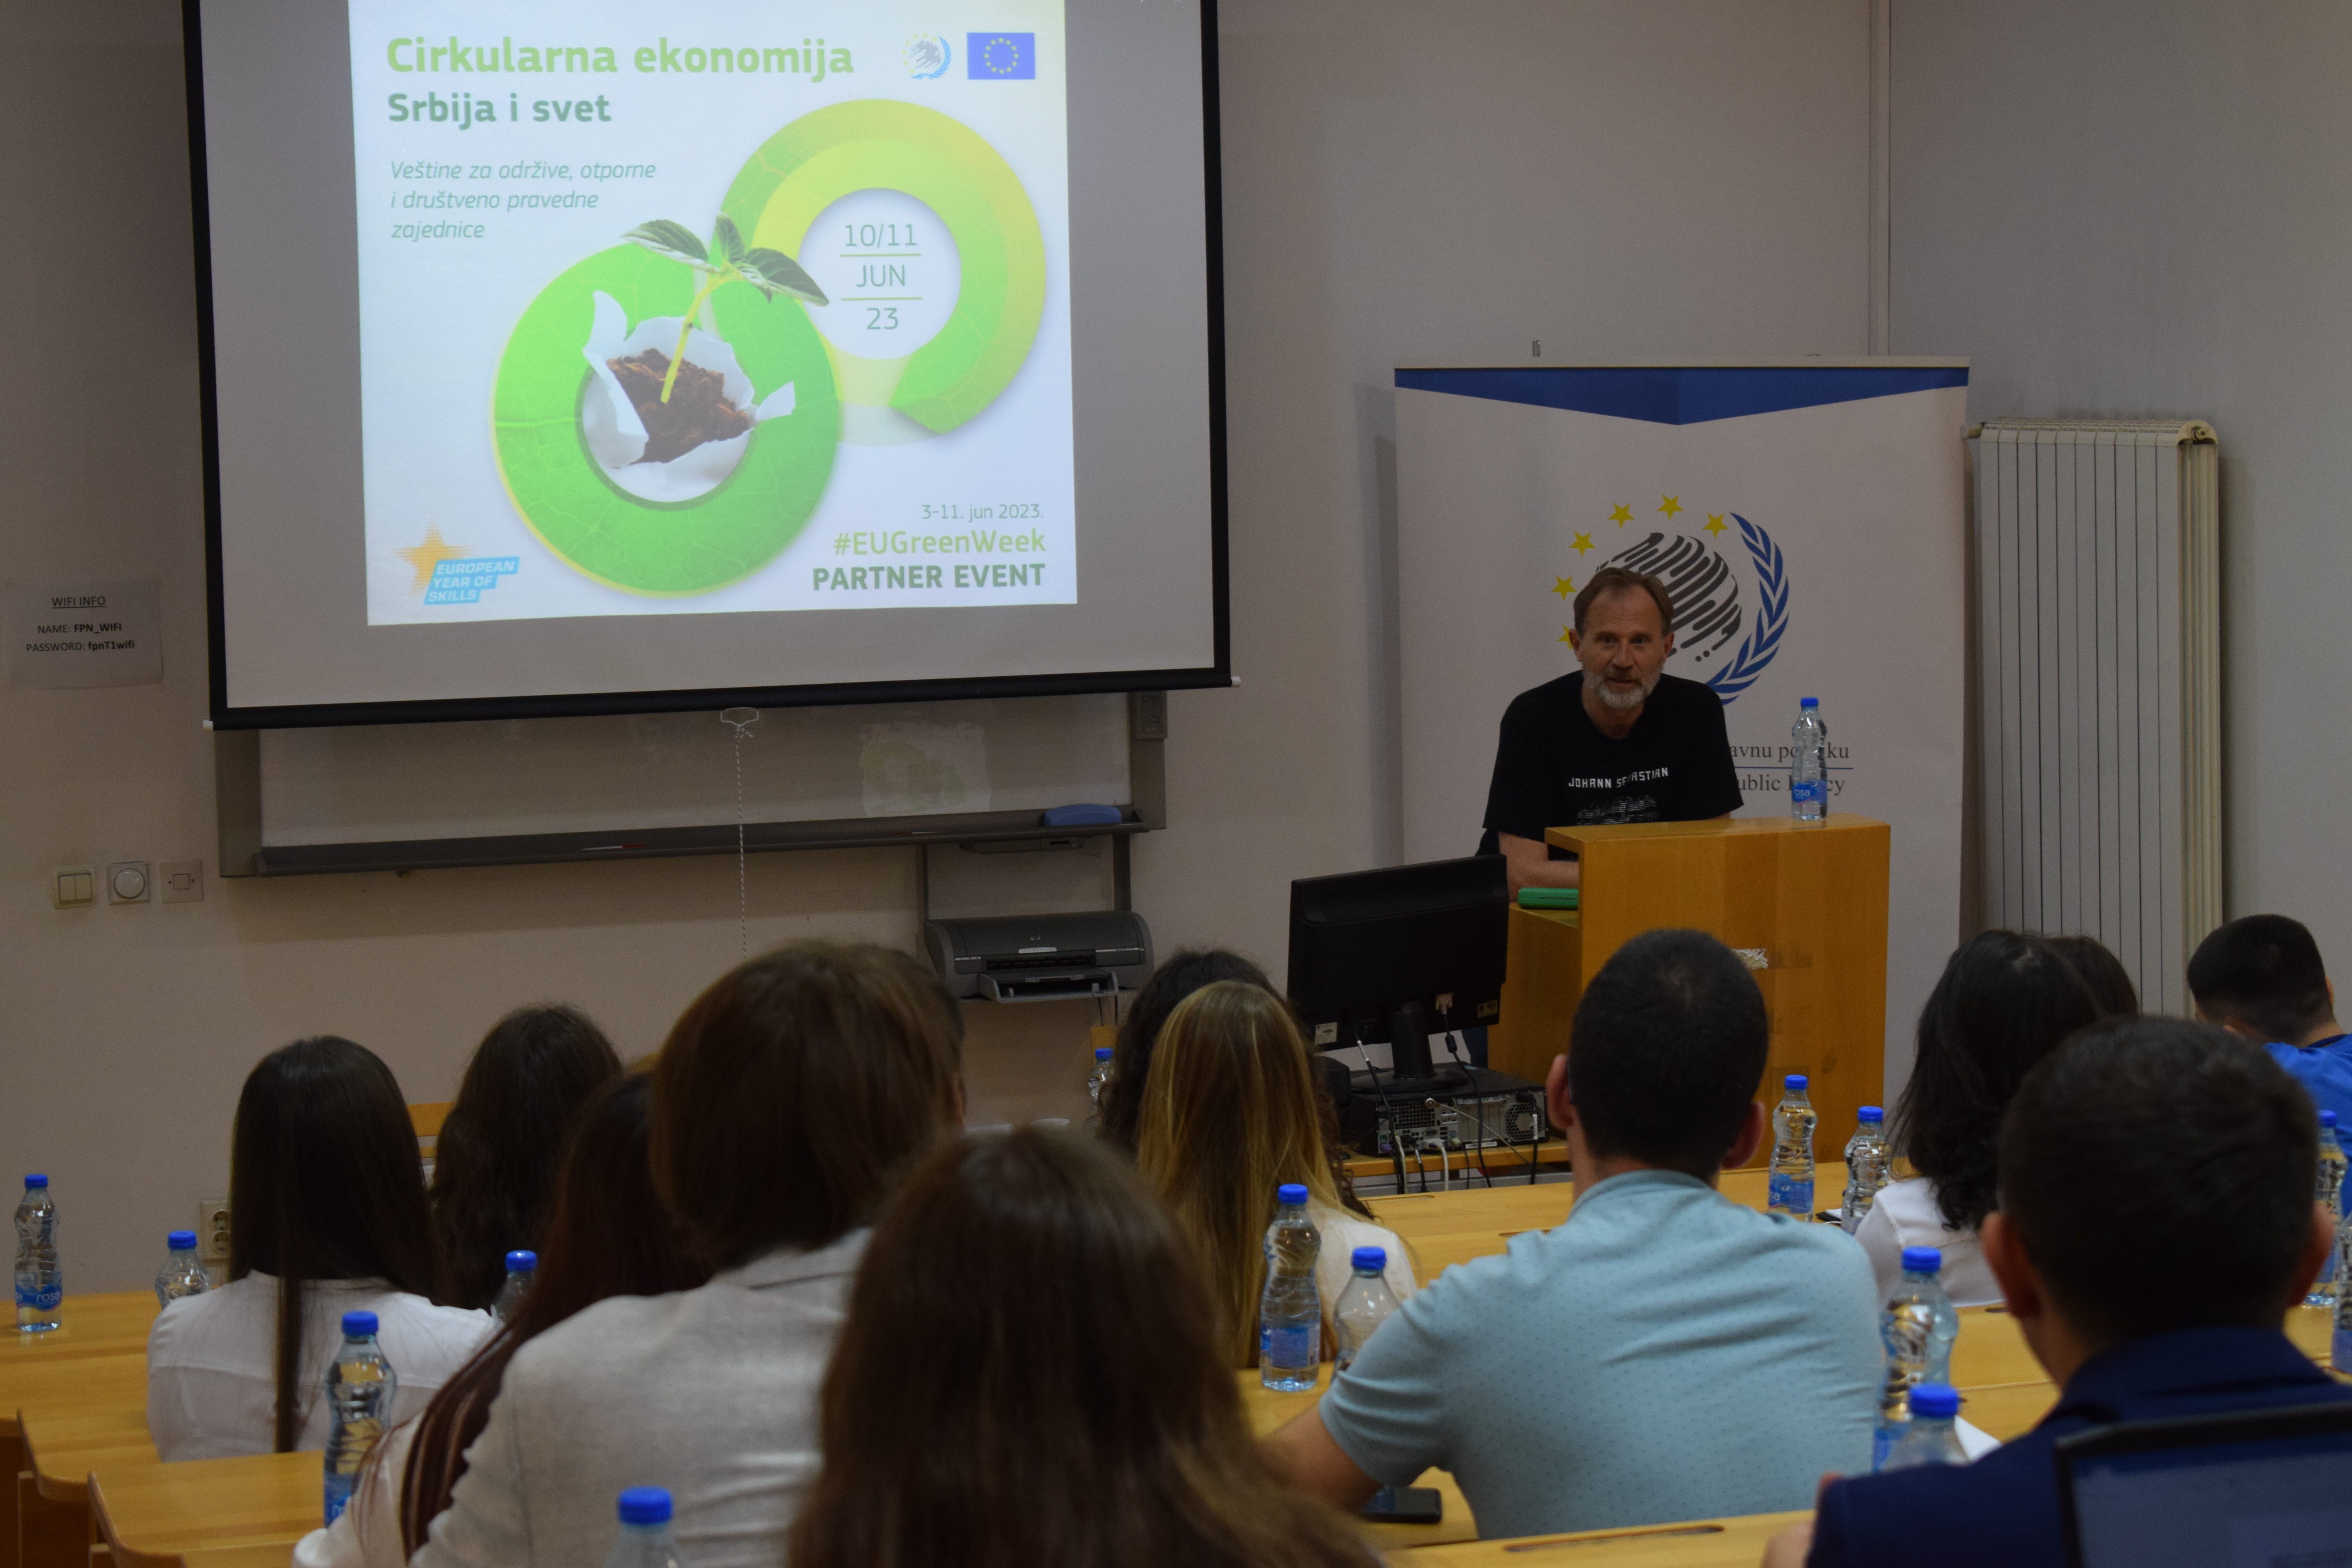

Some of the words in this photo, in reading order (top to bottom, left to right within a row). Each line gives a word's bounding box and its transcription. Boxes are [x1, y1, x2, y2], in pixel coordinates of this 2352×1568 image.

[387, 36, 618, 73] Cirkularna
[634, 37, 854, 83] ekonomija
[388, 91, 497, 131] Srbija
[510, 92, 518, 122] i
[532, 94, 612, 122] svet
[391, 160, 462, 179] Veštine
[468, 165, 491, 179] za
[499, 161, 572, 181] održive,
[581, 162, 656, 182] otporne
[391, 191, 397, 208] i
[403, 191, 500, 209] društveno
[507, 190, 598, 212] pravedne
[392, 221, 485, 242] zajednice
[845, 223, 917, 248] 10/11
[856, 265, 906, 287] JUN
[866, 307, 898, 330] 23
[922, 504, 964, 519] 3-11.
[968, 505, 993, 523] jun
[998, 504, 1044, 519] 2023.
[833, 528, 1046, 555] #EUGreenWeek
[436, 561, 515, 574] EUROPEAN
[813, 564, 943, 591] PARTNER
[954, 563, 1046, 588] EVENT
[434, 576, 470, 588] YEAR
[474, 575, 493, 586] OF
[51, 597, 76, 607] WIFI
[80, 596, 105, 606] INFO
[428, 590, 477, 602] SKILLS
[38, 624, 71, 633] NAME:
[74, 623, 122, 633] FPN_WIFI
[26, 642, 85, 652] PASSWORD:
[87, 640, 135, 652] fpnT1wifi
[1730, 746, 1773, 758] avnu
[1568, 778, 1612, 788] JOHANN
[1737, 774, 1780, 791] ublic
